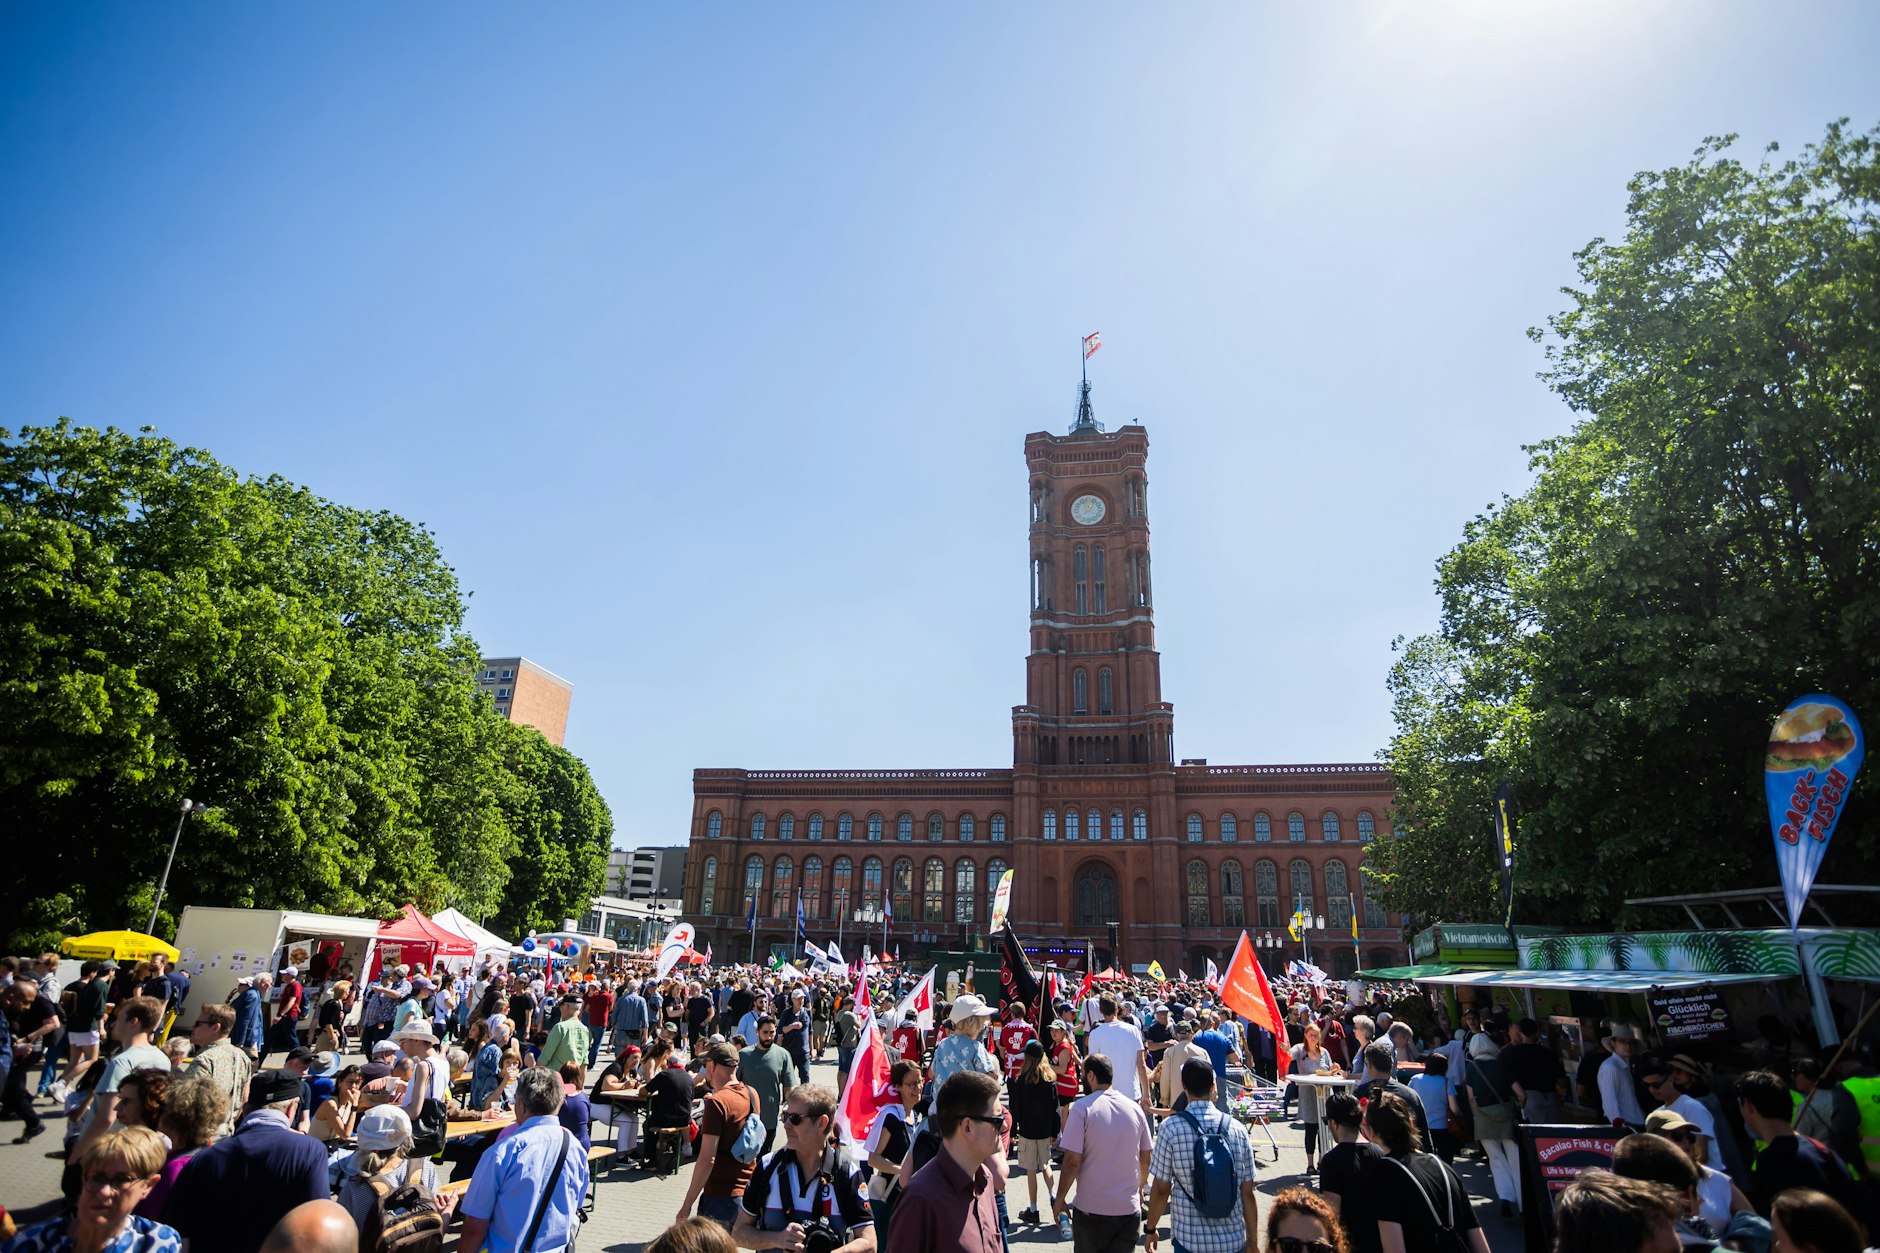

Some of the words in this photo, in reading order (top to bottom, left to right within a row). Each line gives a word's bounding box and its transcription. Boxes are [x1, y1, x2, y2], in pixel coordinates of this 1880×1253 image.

[1778, 770, 1817, 845] BACK-
[1807, 768, 1848, 841] FISCH
[1444, 932, 1510, 945] Vietnamesische
[1668, 1003, 1710, 1014] Glücklich
[1667, 1022, 1725, 1034] FISCHBRÖTCHEN
[1539, 1141, 1572, 1160] Bacalao
[1573, 1138, 1592, 1149] Fish
[1594, 1140, 1602, 1150] &
[1546, 1167, 1558, 1175] Life
